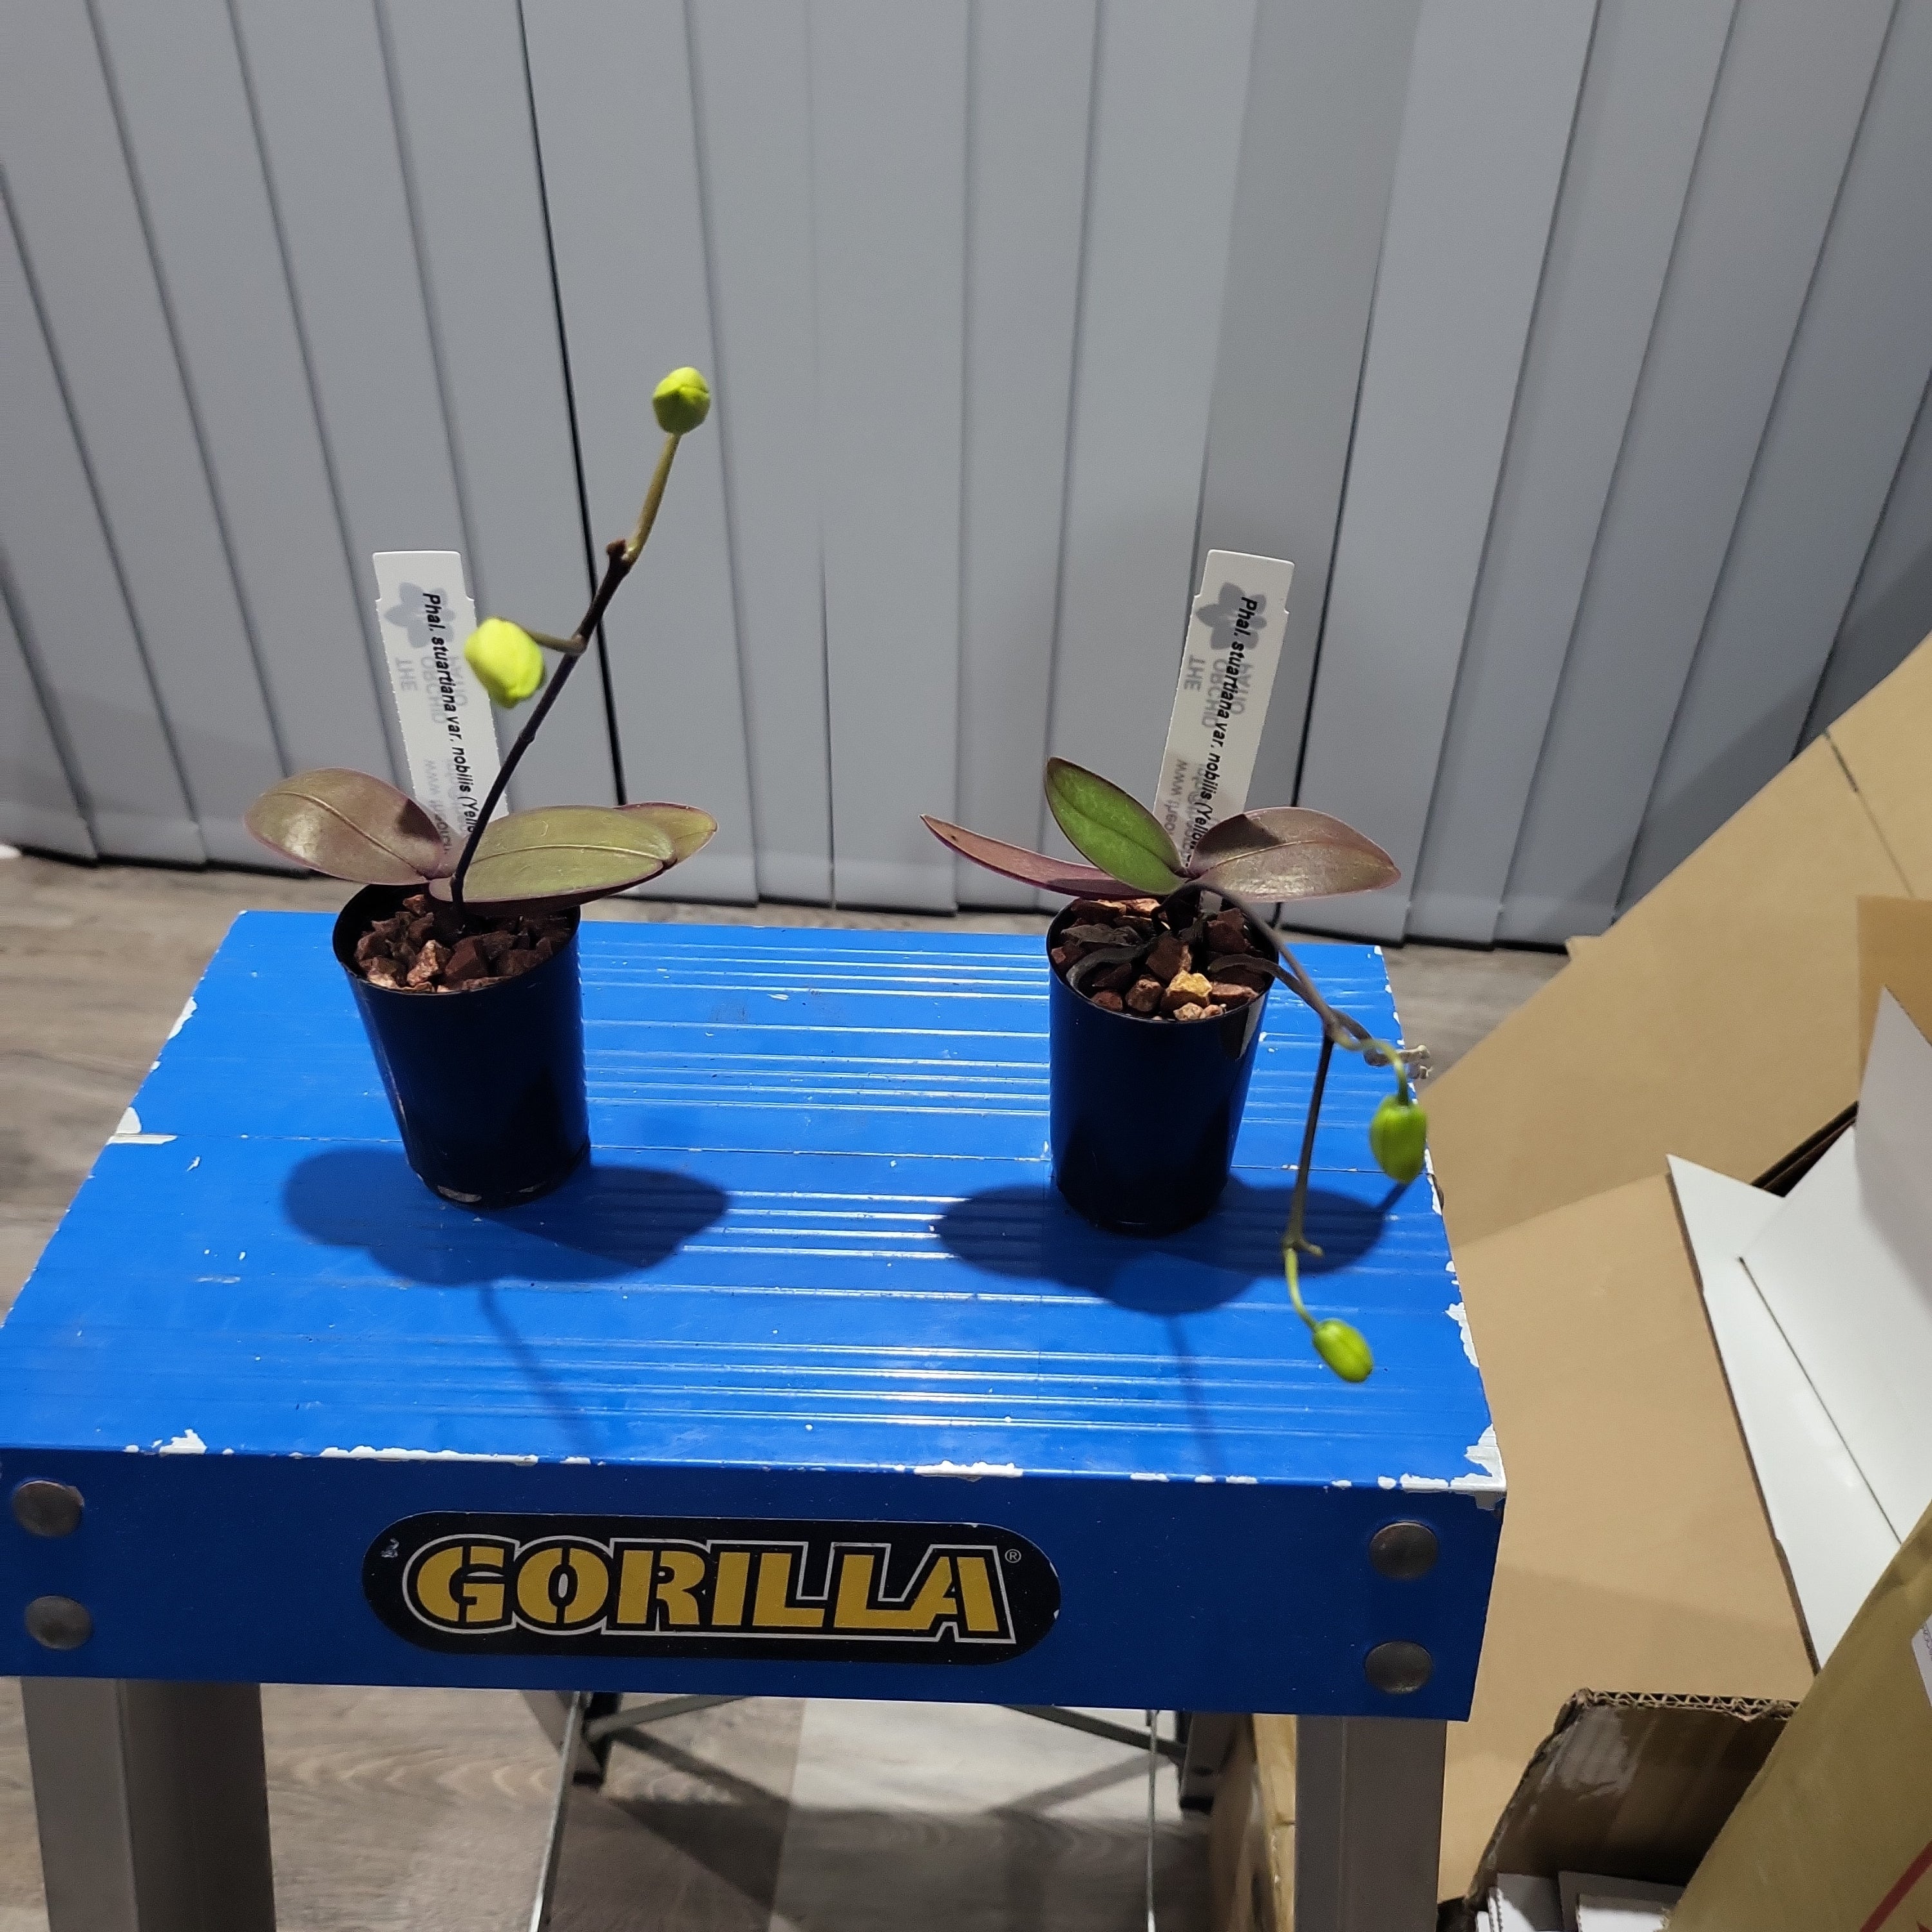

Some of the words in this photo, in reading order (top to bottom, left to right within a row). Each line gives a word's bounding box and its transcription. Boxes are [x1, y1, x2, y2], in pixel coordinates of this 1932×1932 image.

[422, 592, 446, 632] Phal.
[1233, 596, 1258, 637] Phal.
[431, 636, 457, 712] stuartiana
[1217, 640, 1245, 719] stuartiana
[446, 715, 462, 742] var.
[1210, 722, 1227, 748] var.
[451, 746, 473, 793] nobilis
[1200, 752, 1221, 801] nobilis
